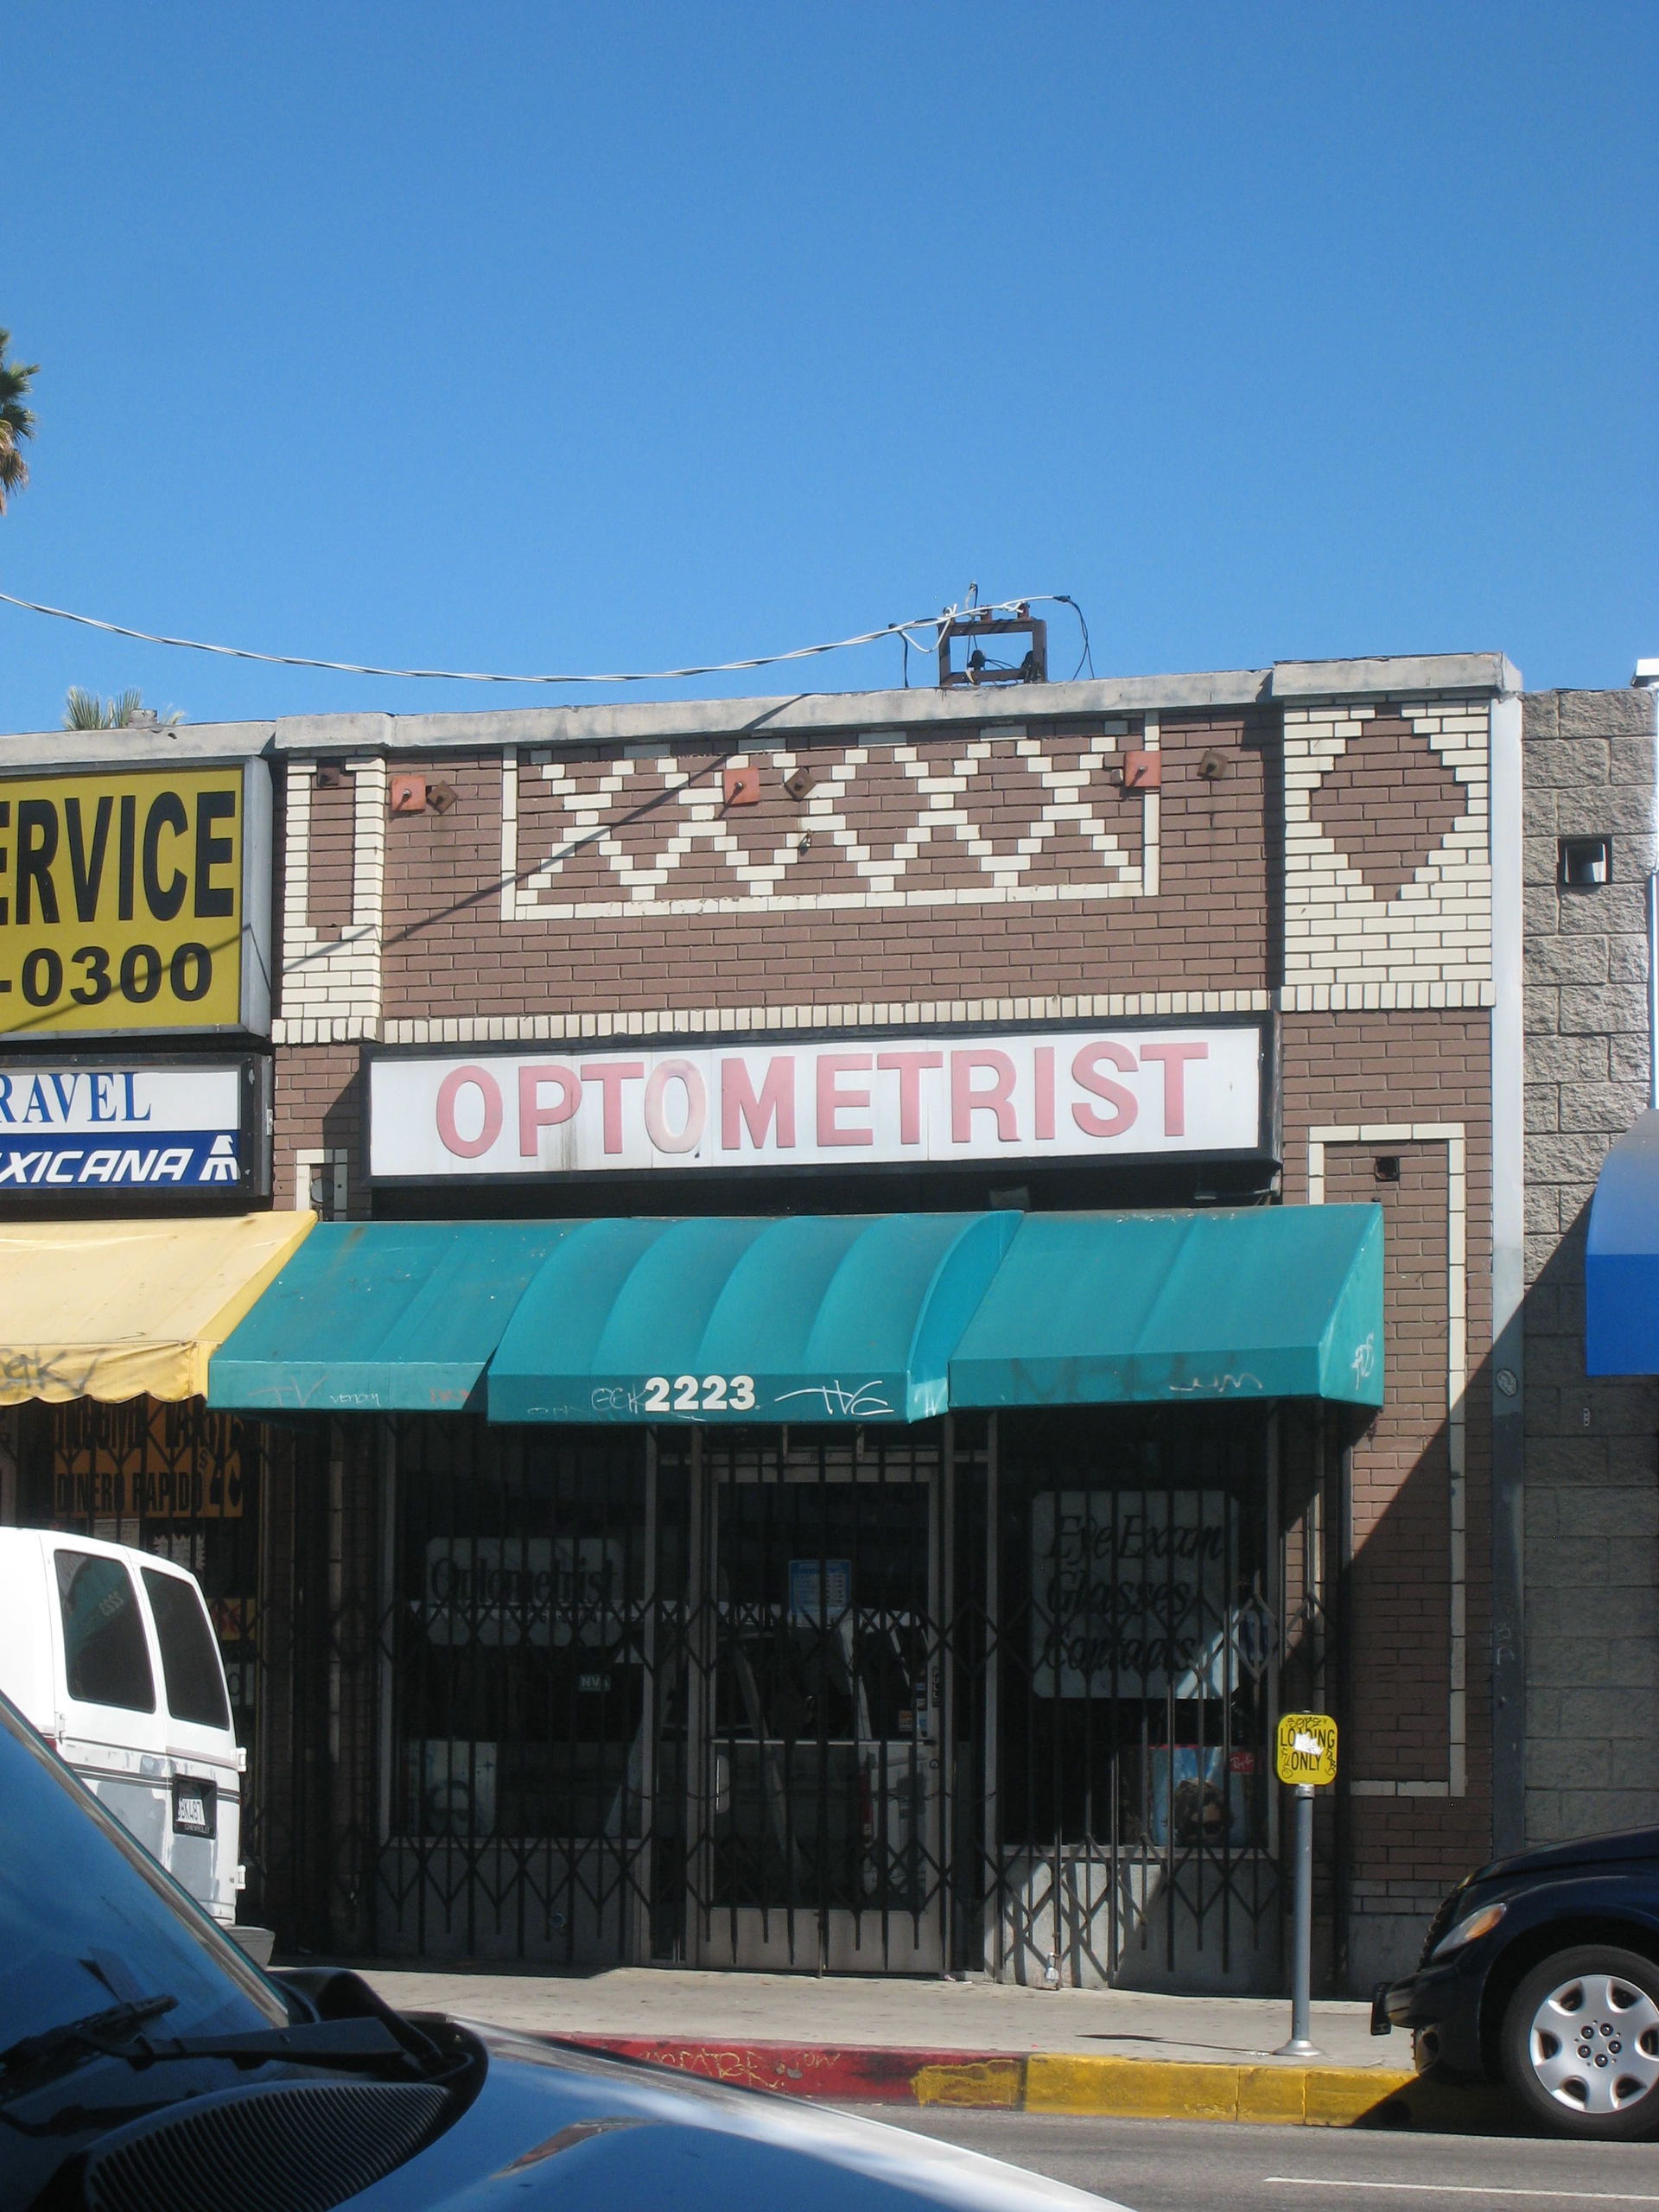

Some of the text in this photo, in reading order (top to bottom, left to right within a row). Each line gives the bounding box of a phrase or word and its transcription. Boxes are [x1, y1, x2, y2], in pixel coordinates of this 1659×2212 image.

[0, 791, 236, 925] RVICE
[435, 1041, 1208, 1159] OPTOMETRIST
[0, 1148, 194, 1184] XICANA
[645, 1375, 756, 1412] 2223
[1280, 1727, 1335, 1748] LODING
[1291, 1751, 1321, 1770] ONLY
